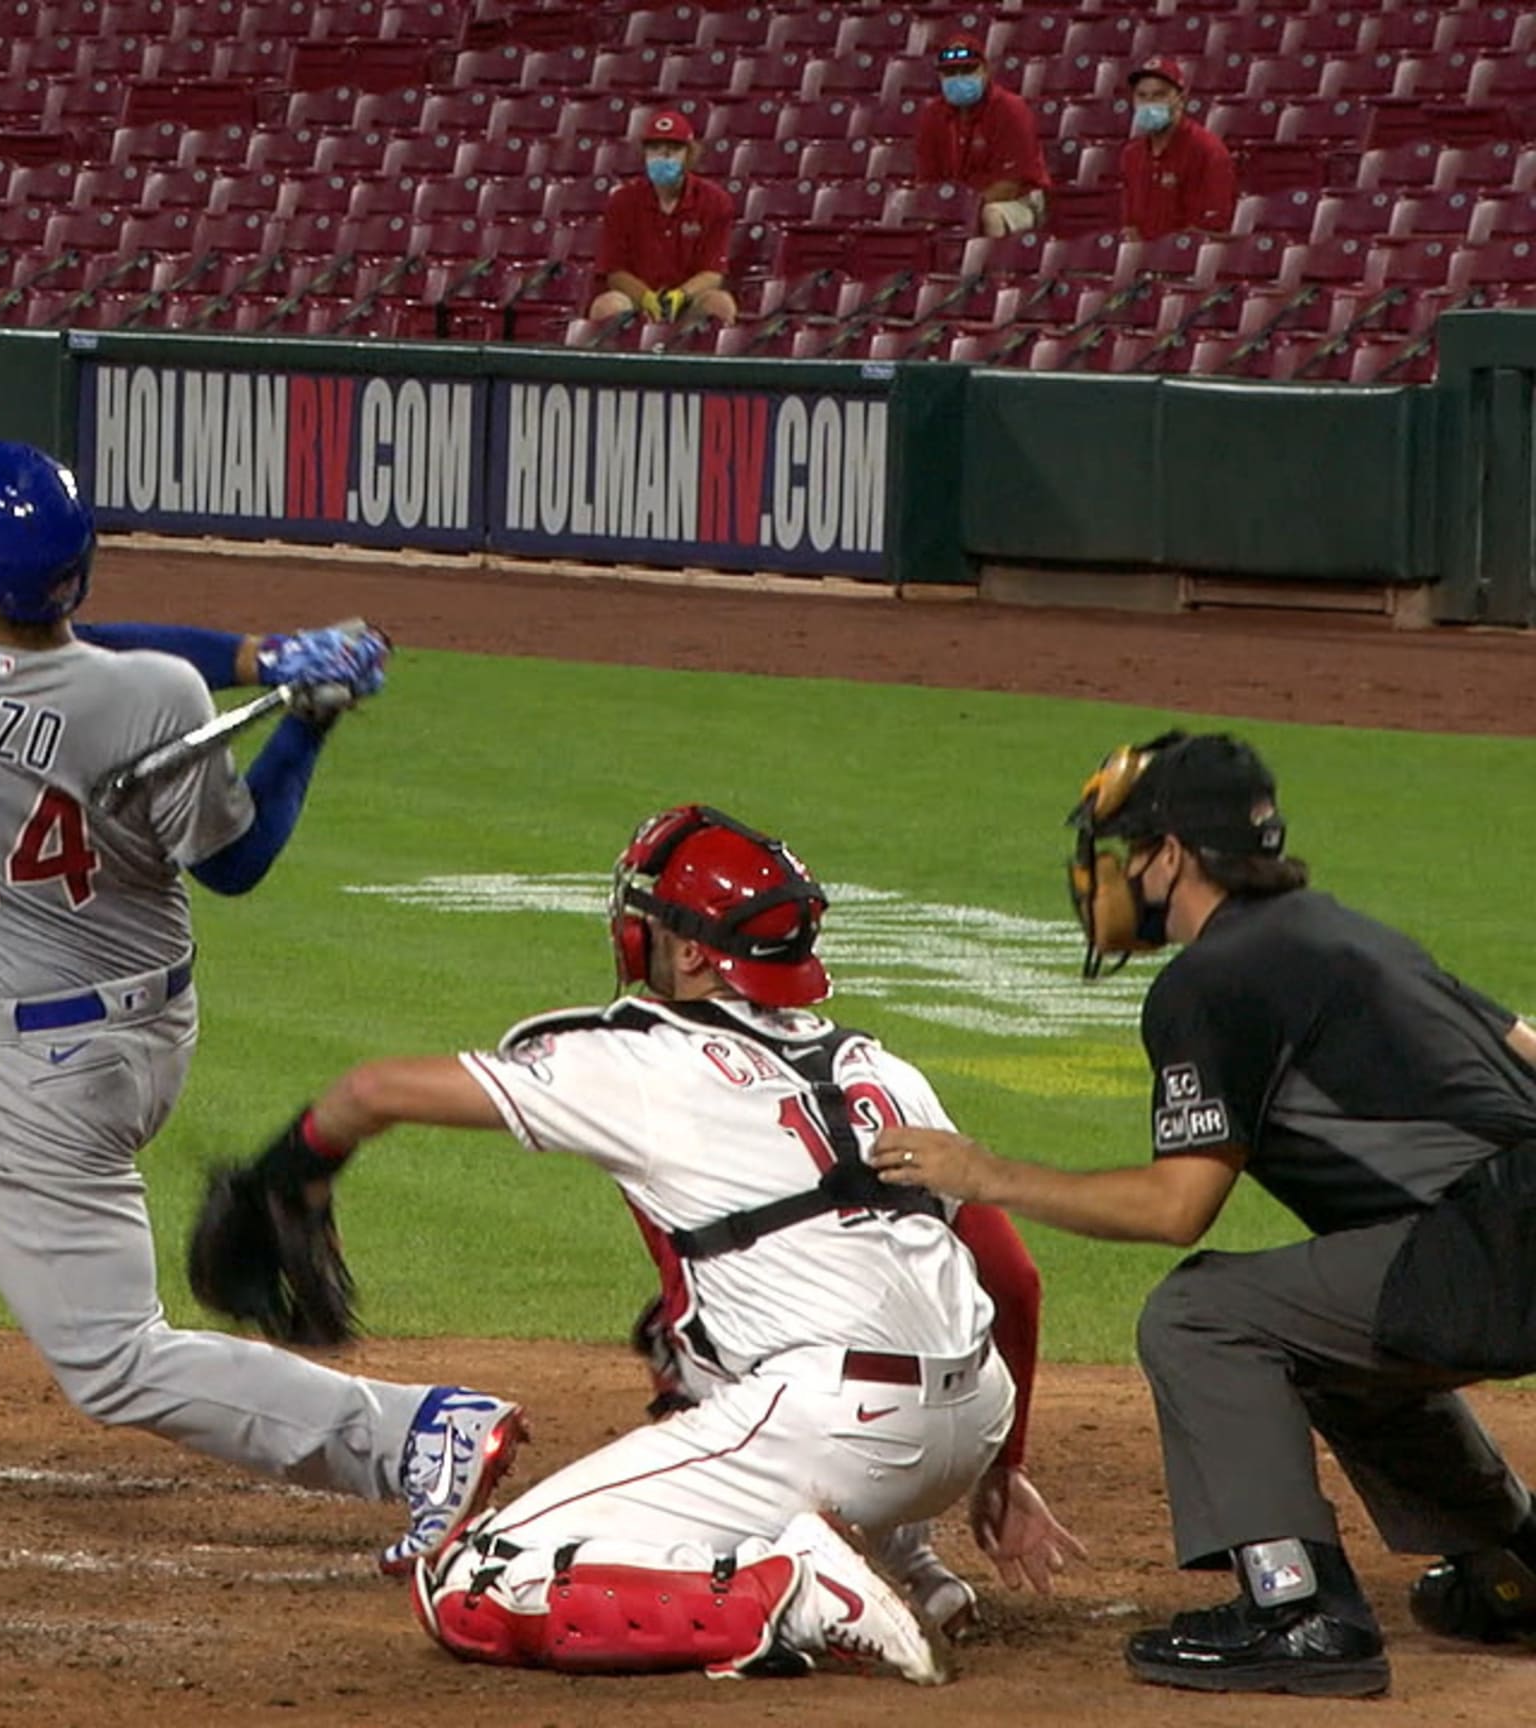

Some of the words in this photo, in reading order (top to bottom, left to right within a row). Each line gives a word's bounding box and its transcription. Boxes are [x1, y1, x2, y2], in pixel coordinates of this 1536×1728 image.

[95, 365, 473, 529] HOLMANRV.COM
[506, 383, 888, 553] HOLMANRV.COM
[1190, 1108, 1223, 1135] RR
